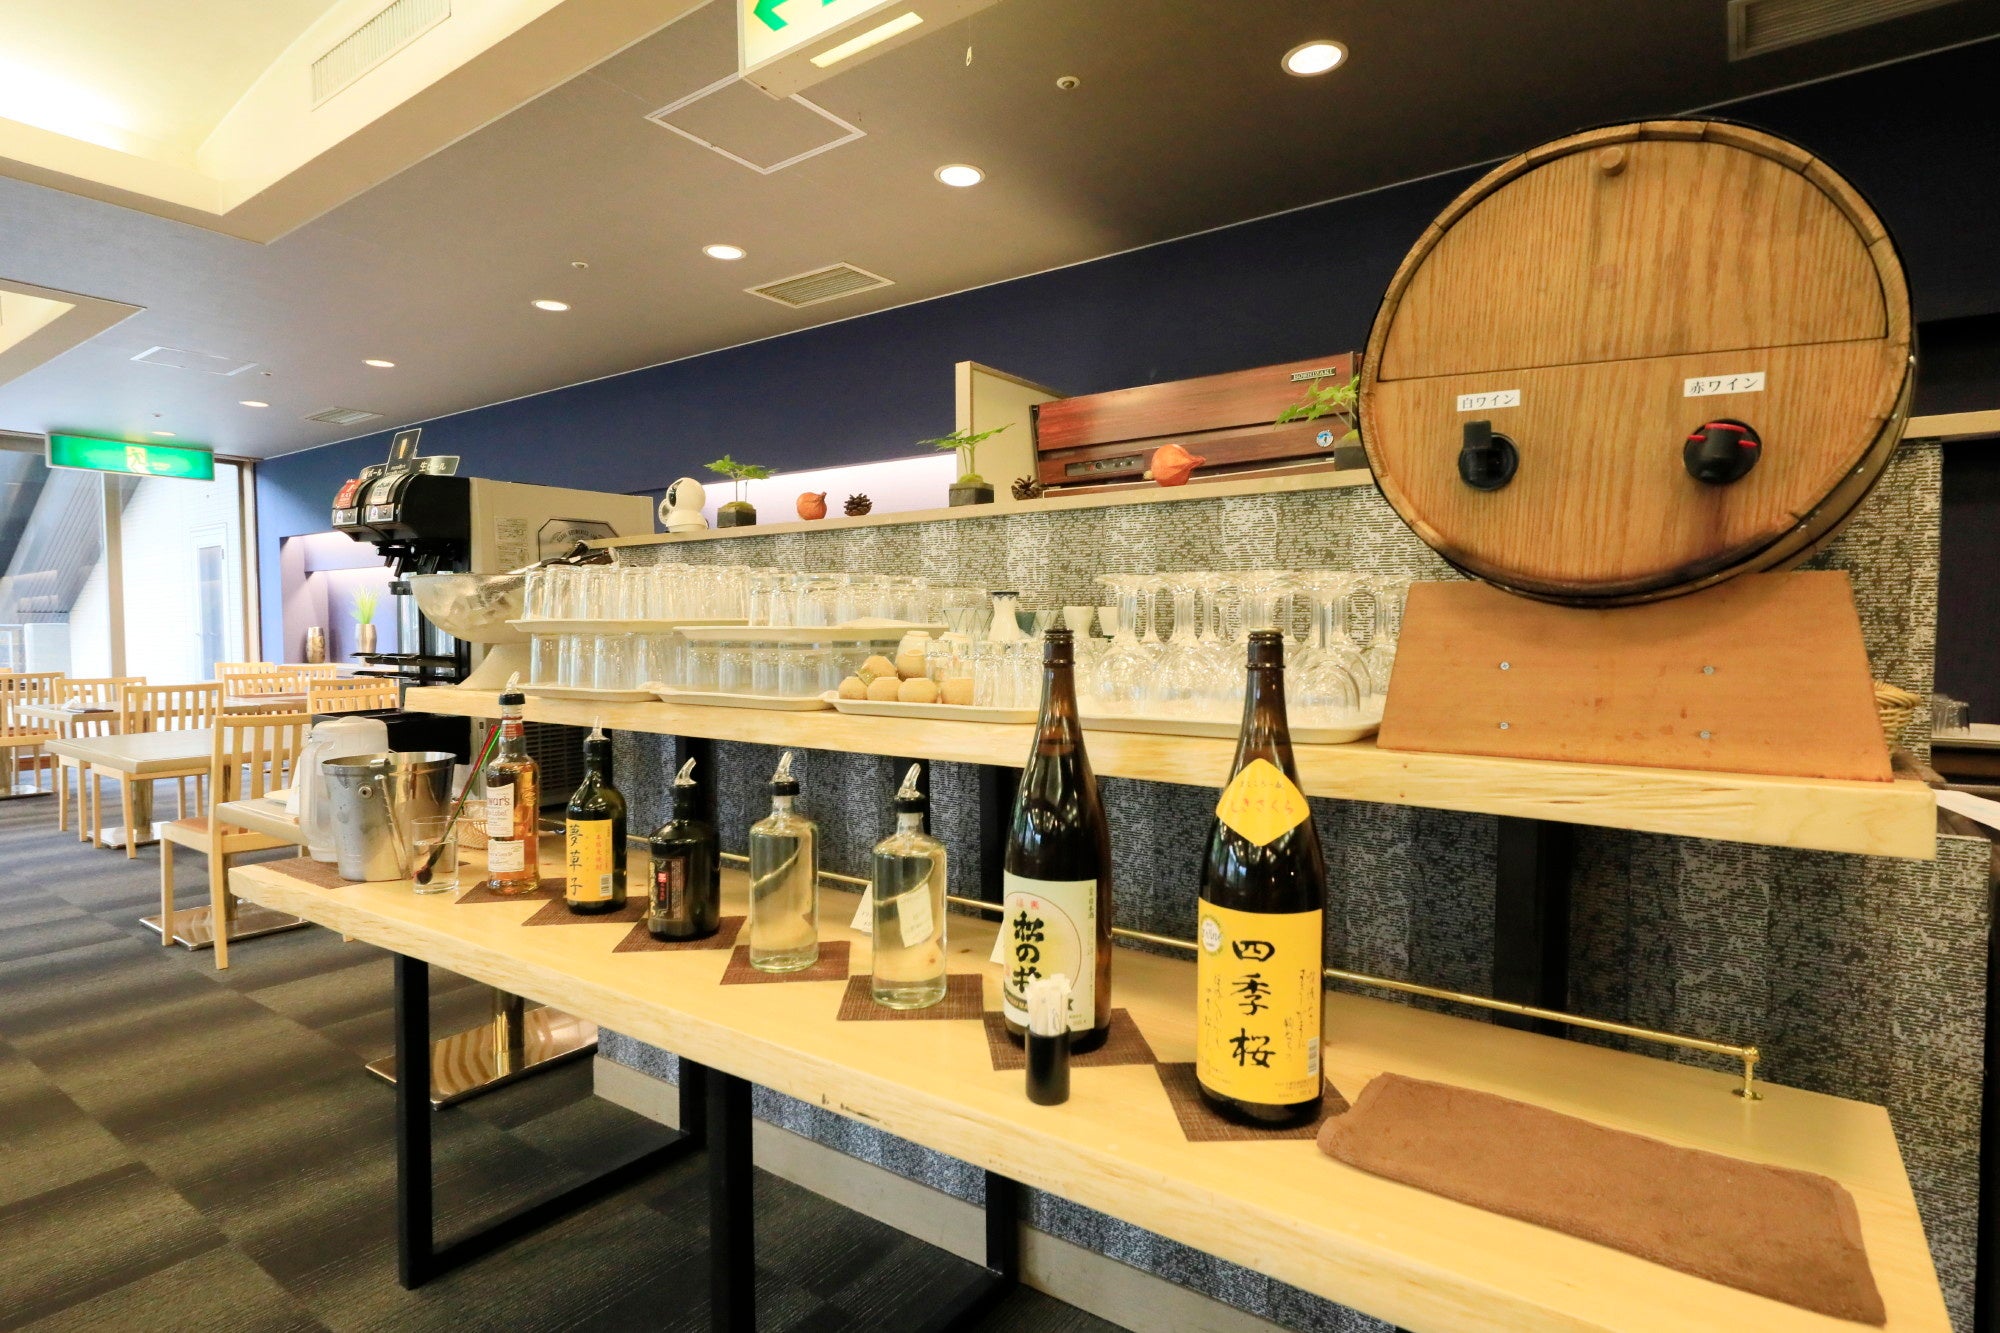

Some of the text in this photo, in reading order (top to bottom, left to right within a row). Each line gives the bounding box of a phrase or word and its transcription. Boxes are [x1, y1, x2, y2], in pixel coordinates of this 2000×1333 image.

[1690, 376, 1758, 394] 赤ワイン
[1461, 393, 1514, 409] 白ワイン
[418, 460, 447, 472] 生ビール
[1231, 798, 1294, 815] しきさくら
[1229, 939, 1276, 1069] 四季桜
